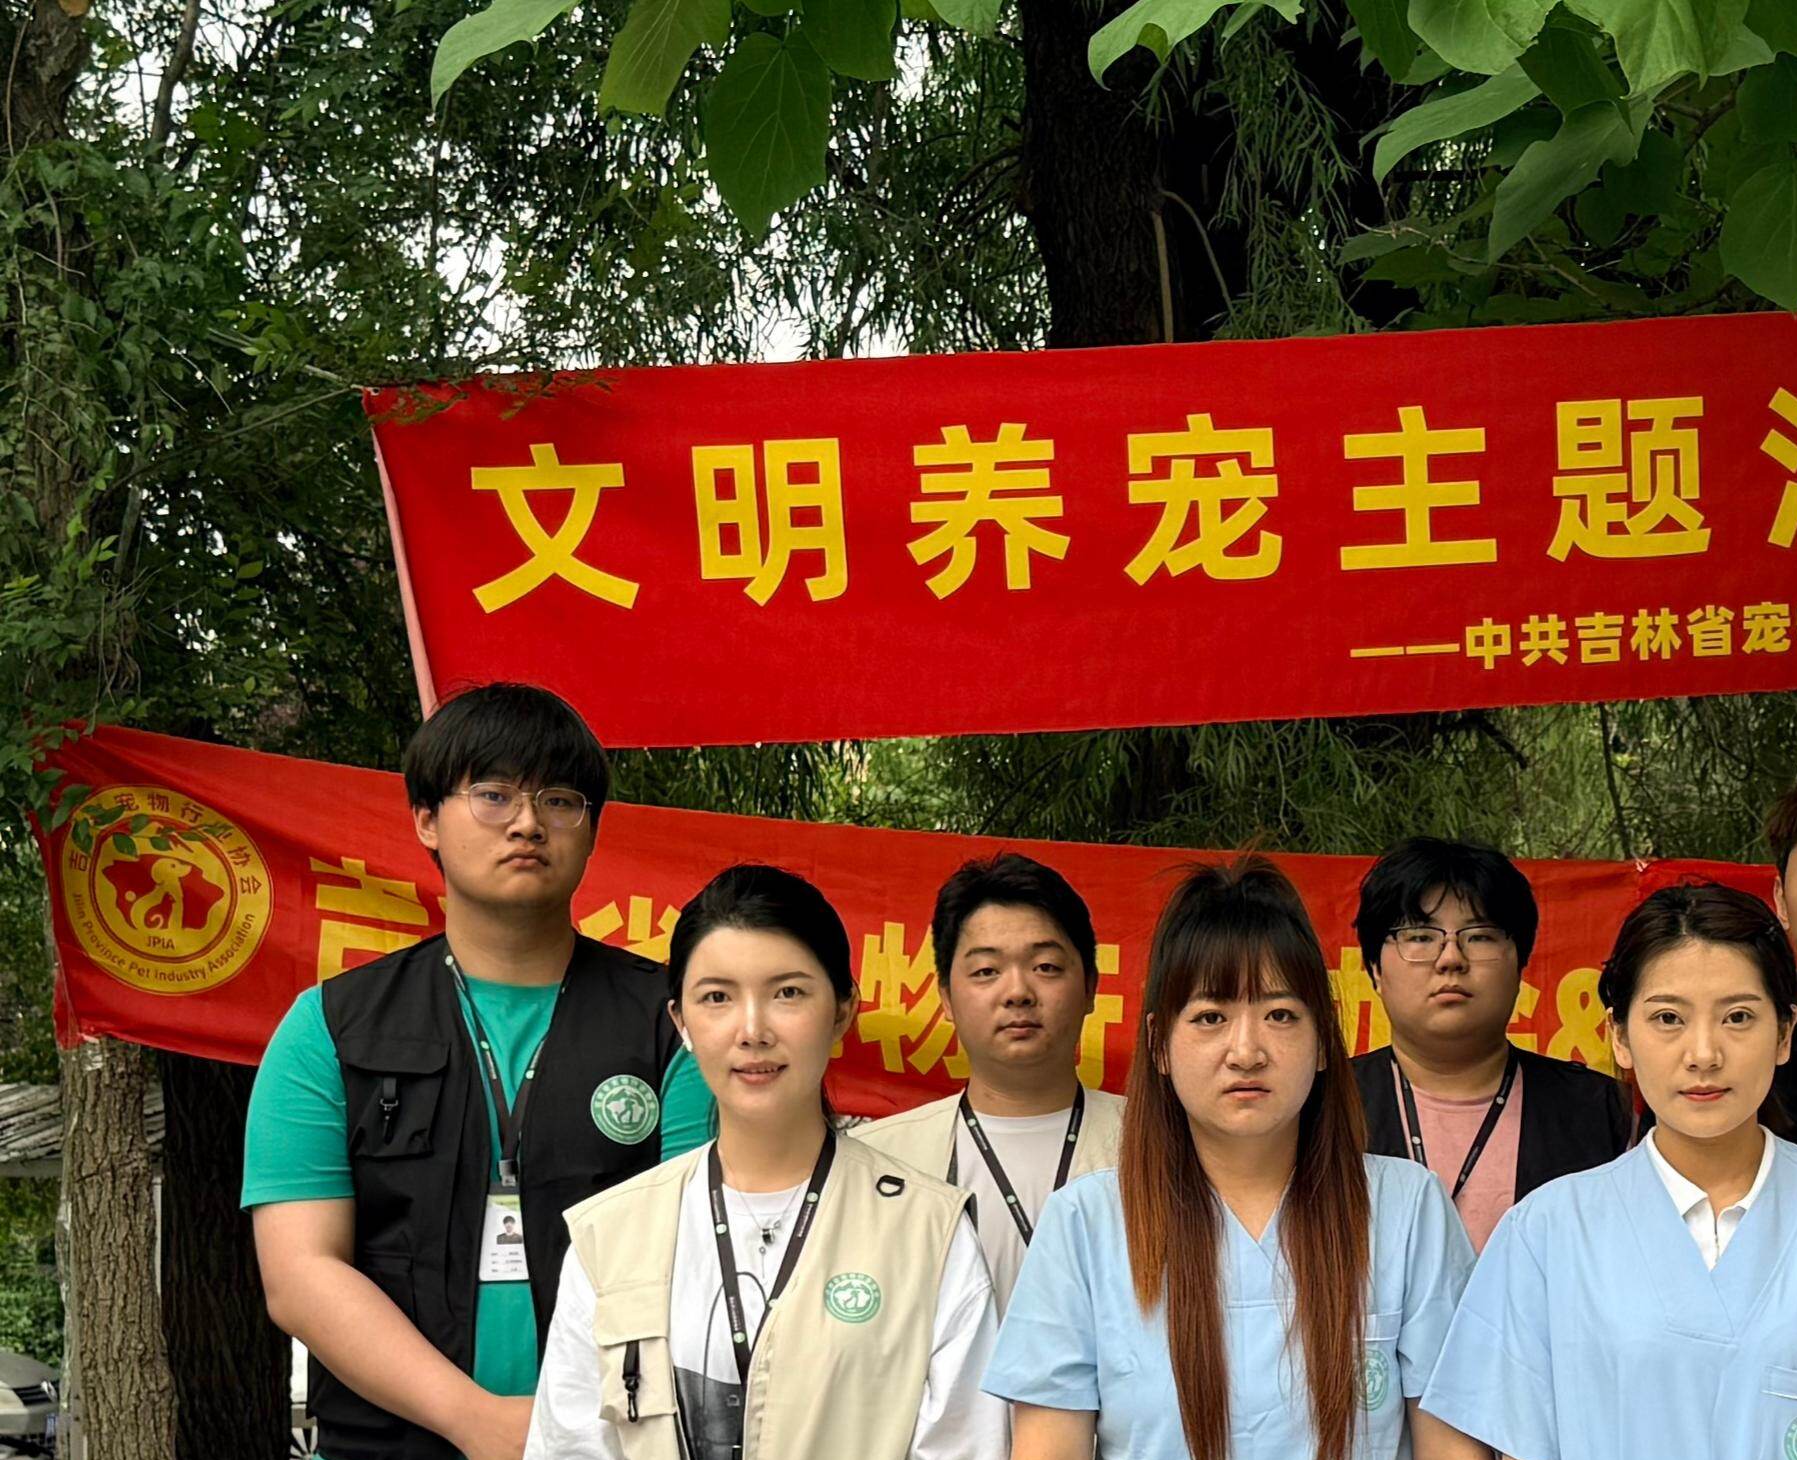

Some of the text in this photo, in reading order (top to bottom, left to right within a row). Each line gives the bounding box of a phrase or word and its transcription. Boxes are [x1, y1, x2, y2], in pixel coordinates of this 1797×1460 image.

[68, 793, 262, 895] 吉宠物行协会
[83, 920, 127, 968] Province
[128, 962, 150, 978] Pet
[154, 966, 209, 983] Industry
[207, 913, 256, 974] Association
[147, 936, 176, 951] JPIA
